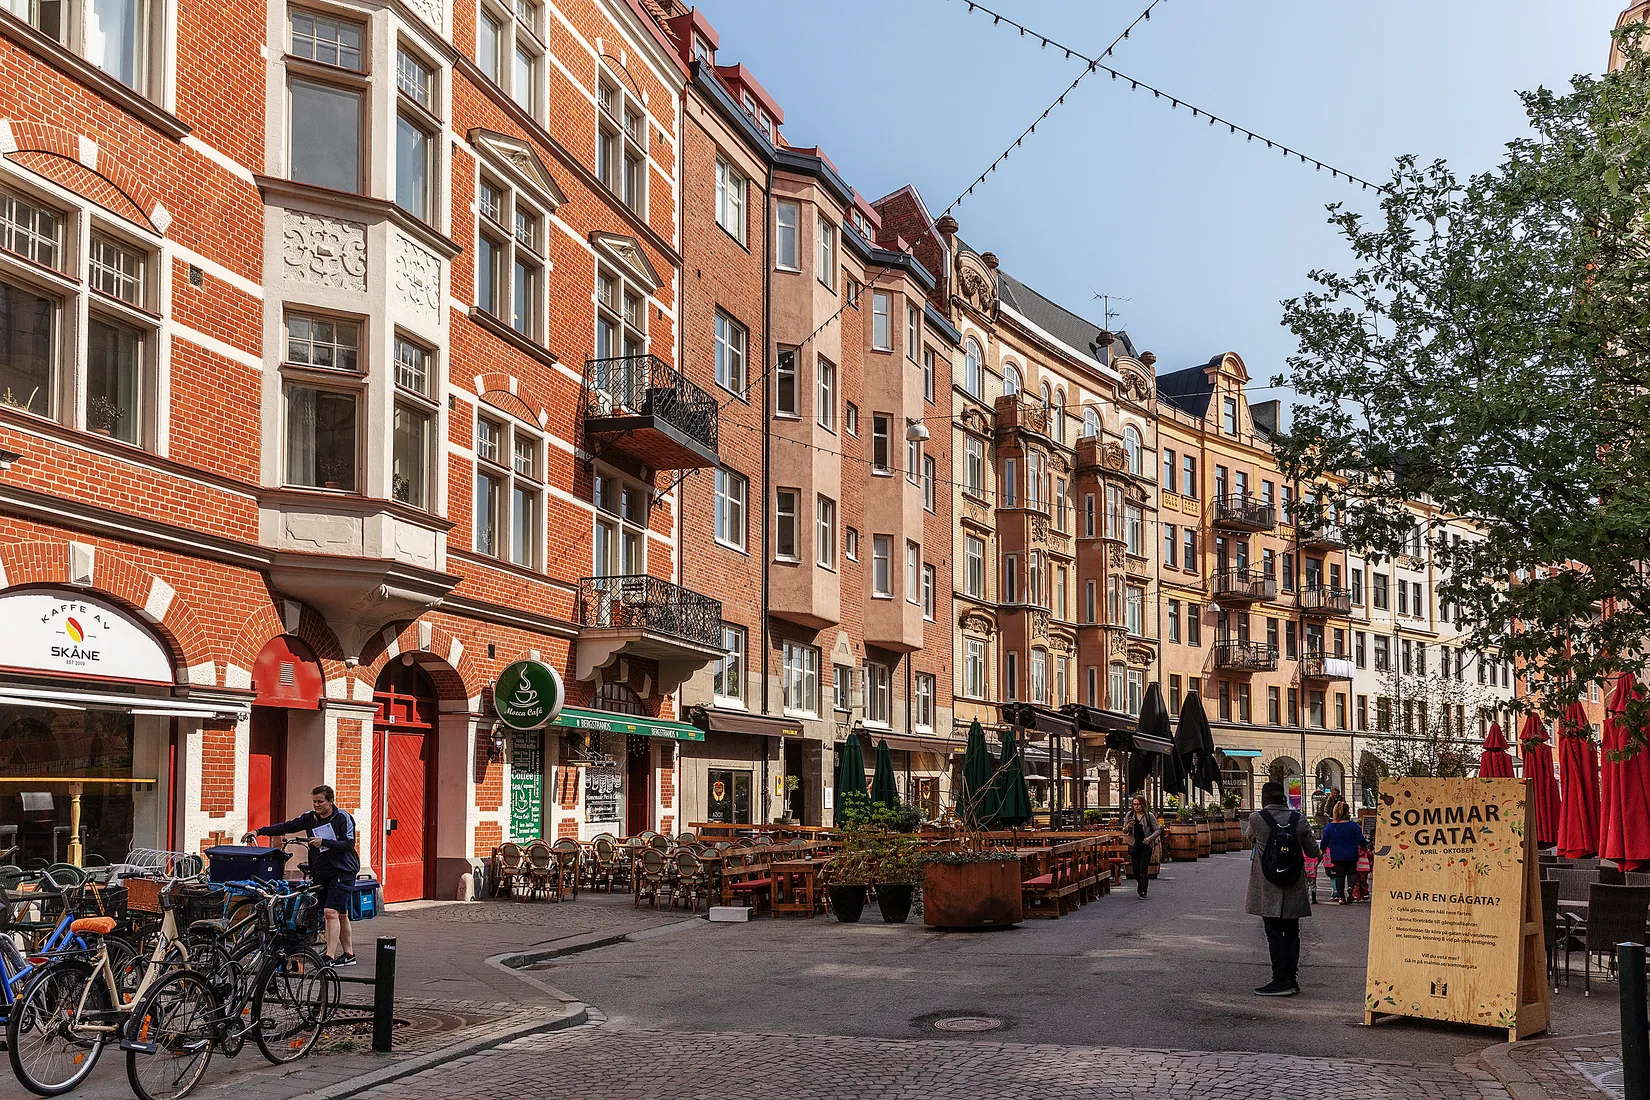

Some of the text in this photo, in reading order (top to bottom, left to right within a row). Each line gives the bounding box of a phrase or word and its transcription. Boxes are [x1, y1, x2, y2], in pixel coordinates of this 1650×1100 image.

[41, 604, 110, 630] KAFFE AL
[51, 645, 100, 661] SKÅNE
[504, 707, 543, 717] Mocca Café
[1390, 804, 1500, 827] SOMMAR
[1414, 827, 1477, 846] GATA
[1390, 891, 1500, 906] VAD ÄR EN GÅGATA?
